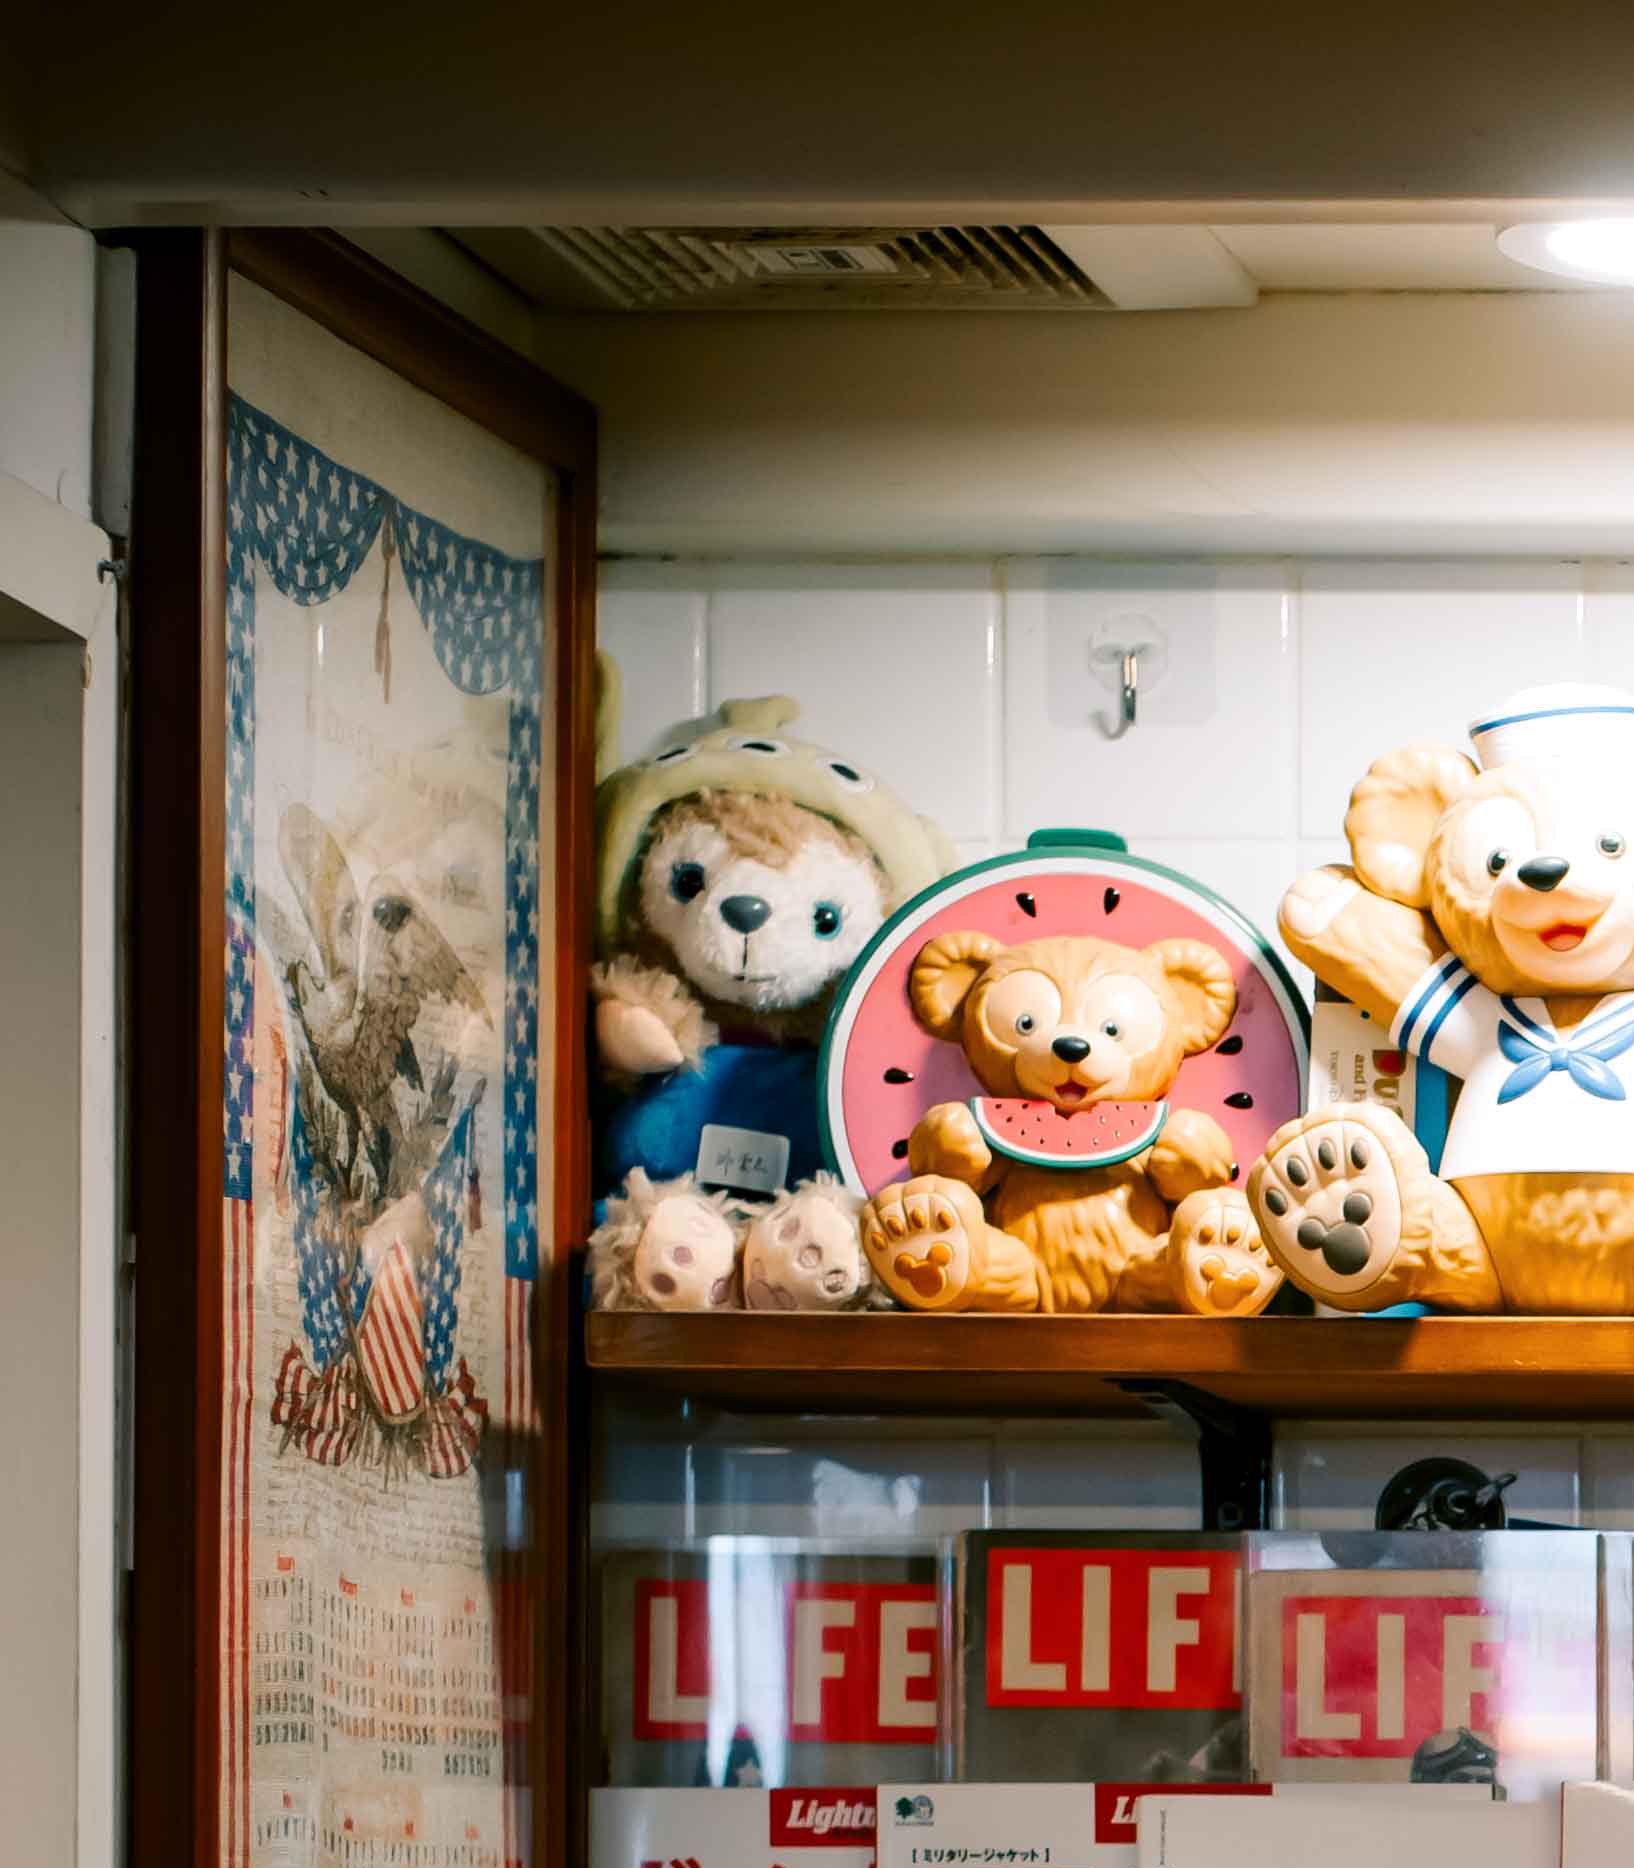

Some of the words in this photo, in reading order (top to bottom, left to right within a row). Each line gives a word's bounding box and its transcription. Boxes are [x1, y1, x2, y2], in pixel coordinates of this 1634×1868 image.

[649, 1596, 937, 1726] LFE
[1001, 1563, 1244, 1692] LIF
[1296, 1613, 1504, 1742] LIF
